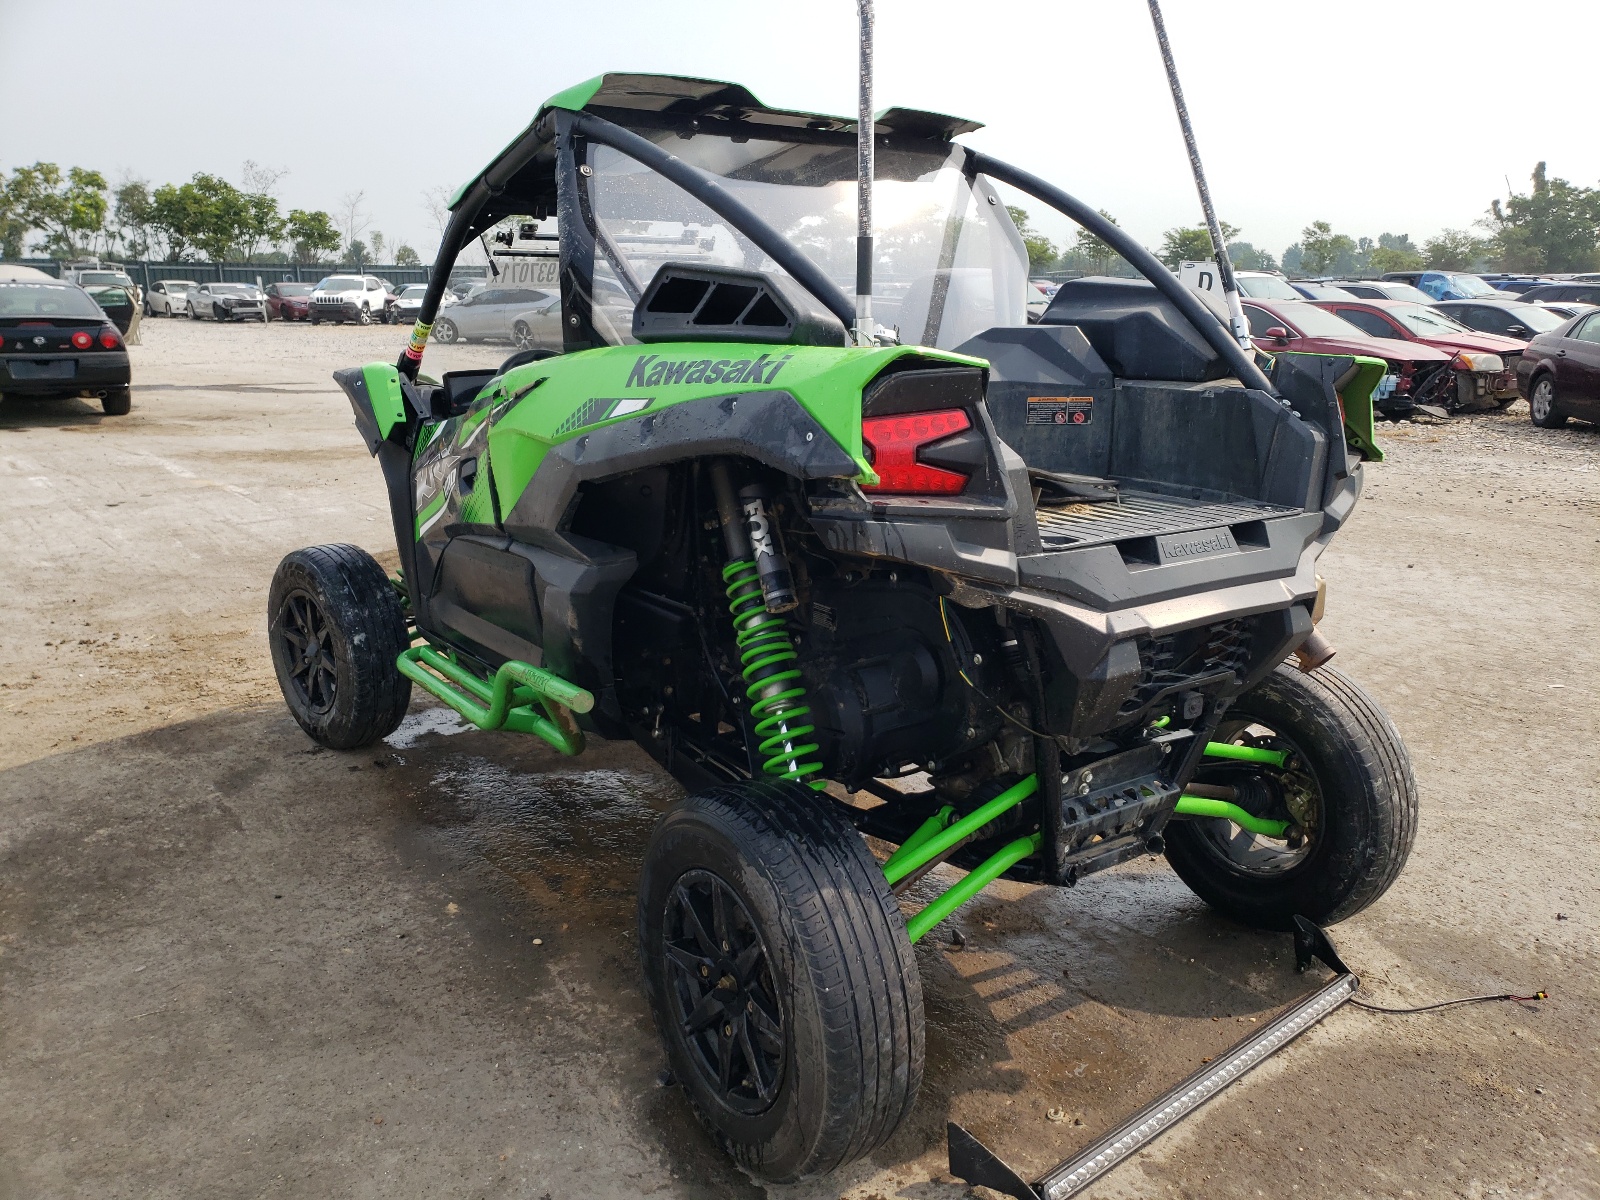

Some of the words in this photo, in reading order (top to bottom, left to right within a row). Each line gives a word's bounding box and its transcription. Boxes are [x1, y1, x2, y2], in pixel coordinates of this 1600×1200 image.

[625, 354, 794, 388] Kawasaki
[744, 499, 774, 561] FOX
[1161, 533, 1232, 558] Kawasaki
